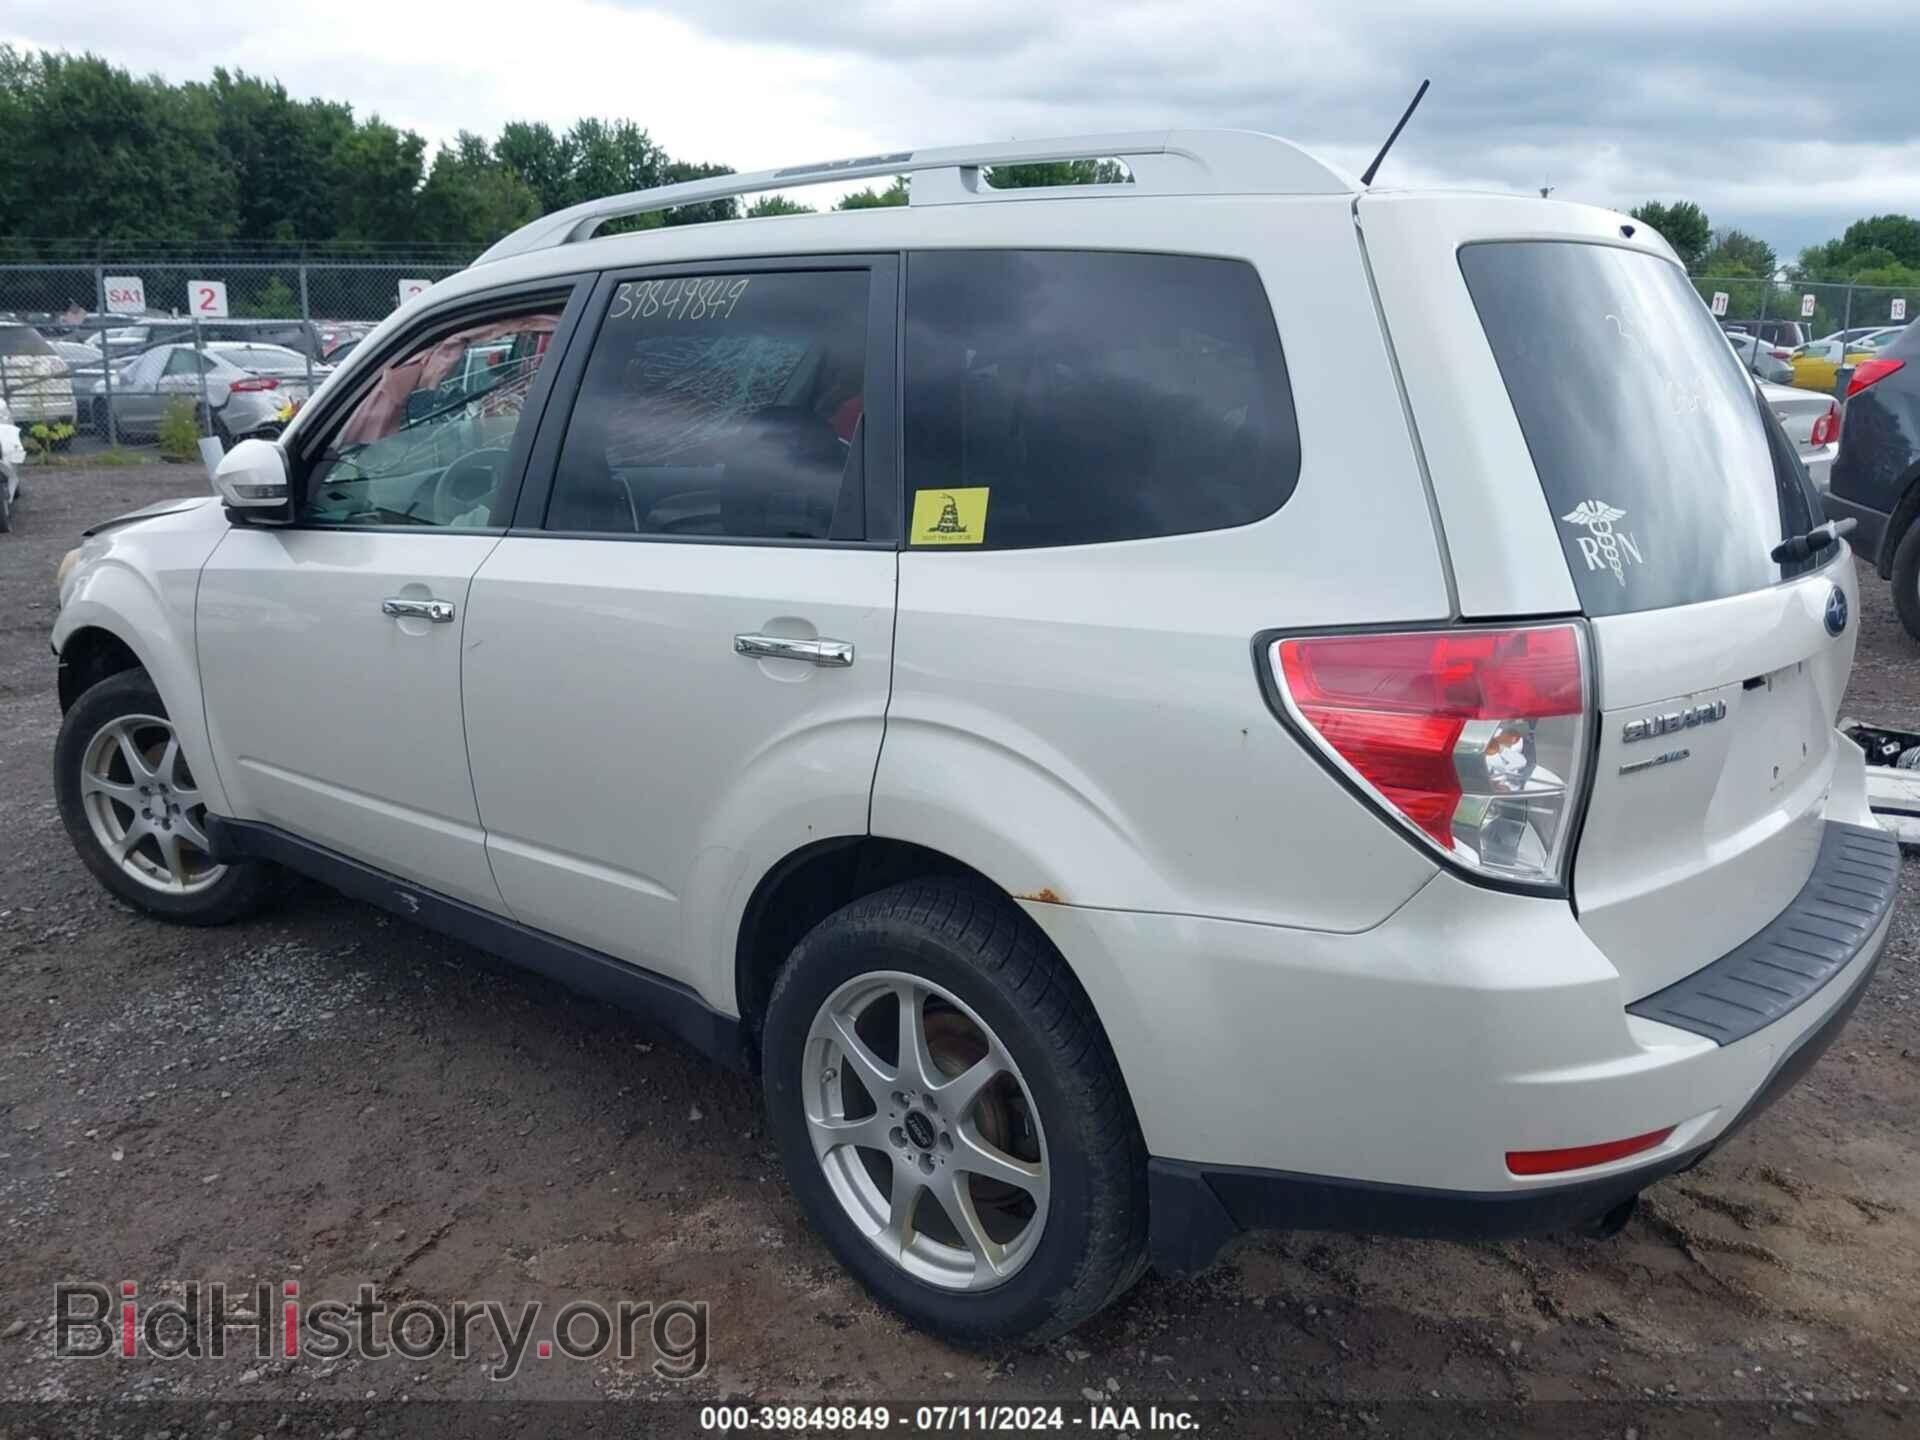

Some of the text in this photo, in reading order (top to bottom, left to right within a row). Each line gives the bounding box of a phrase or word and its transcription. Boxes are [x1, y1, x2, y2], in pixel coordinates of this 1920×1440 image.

[108, 289, 142, 304] SA1
[199, 287, 218, 311] 2
[610, 278, 749, 320] 39849849
[1803, 297, 1815, 313] 12
[1892, 302, 1905, 318] 13
[1622, 699, 1727, 744] SUBARU
